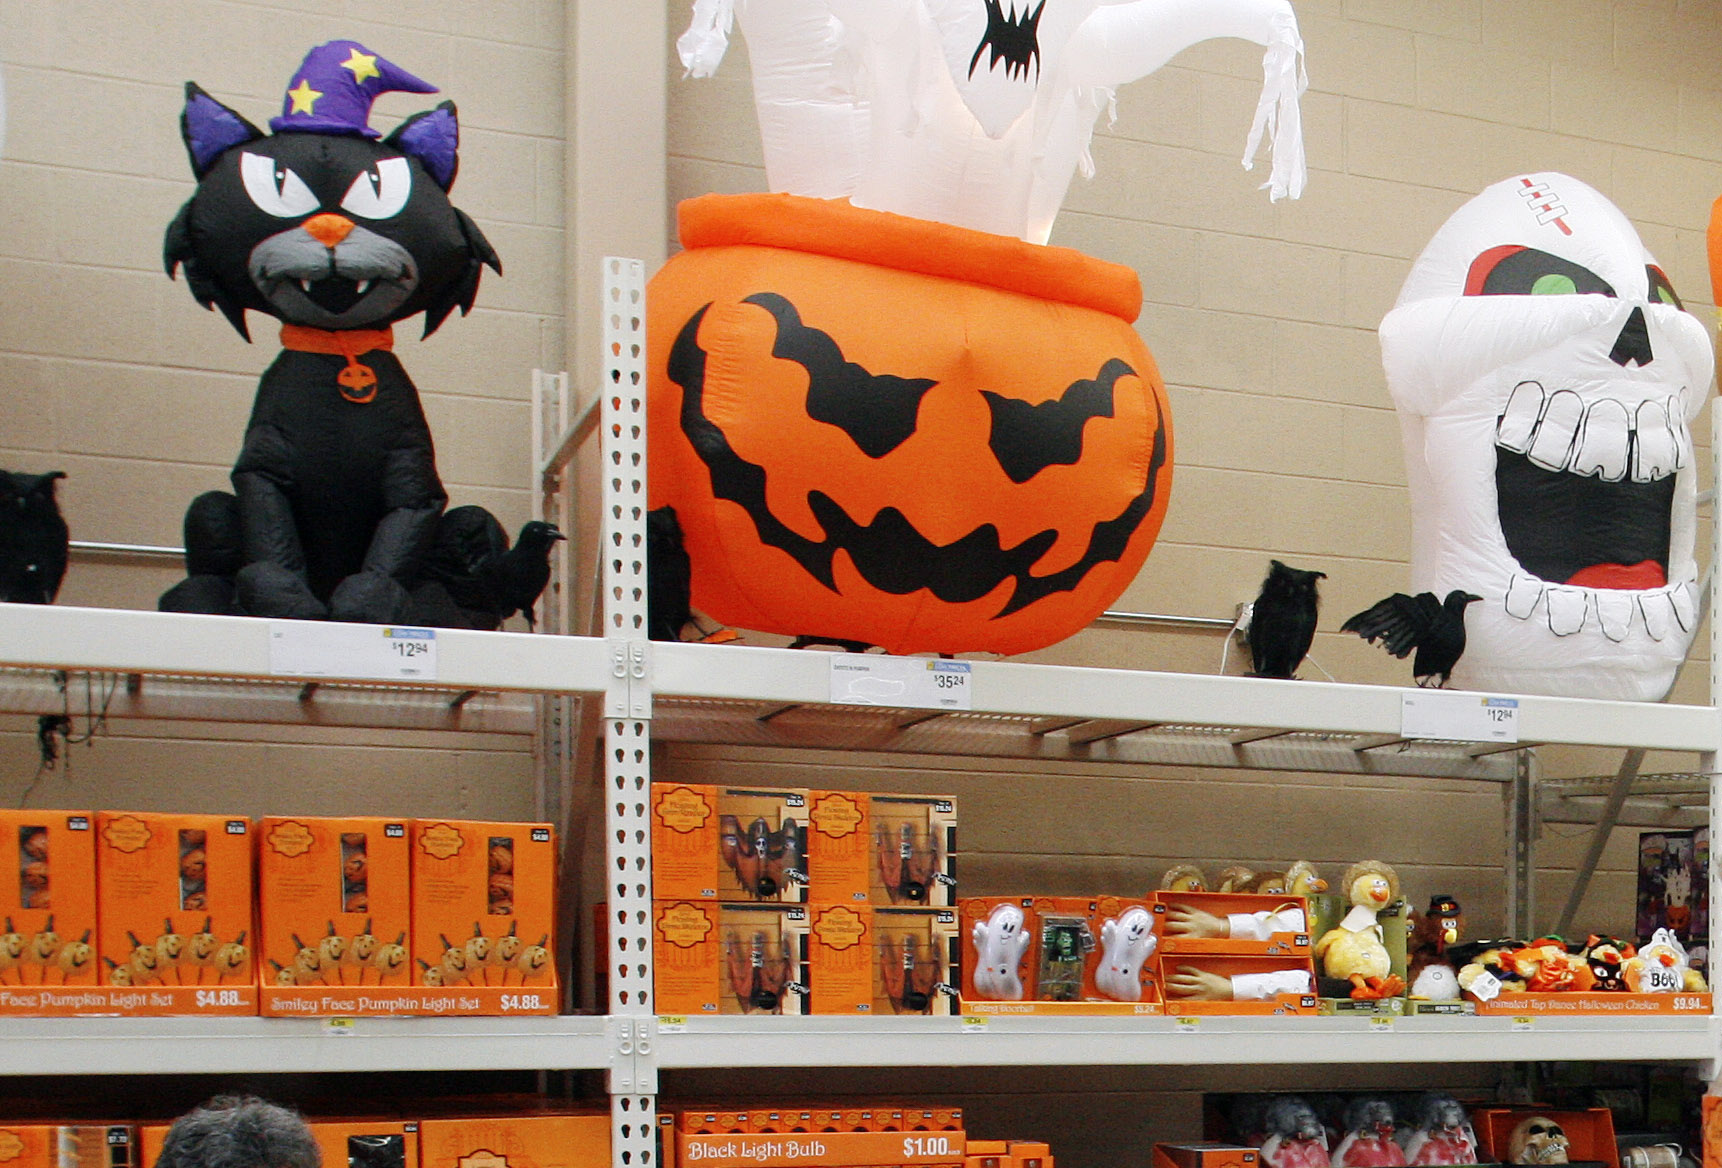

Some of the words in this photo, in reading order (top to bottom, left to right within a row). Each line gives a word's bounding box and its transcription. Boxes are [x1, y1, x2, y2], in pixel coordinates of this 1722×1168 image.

[40, 992, 106, 1009] Pumpkin
[109, 991, 146, 1008] Light
[150, 992, 173, 1006] Set
[195, 990, 239, 1008] $4.88
[271, 997, 318, 1013] Smiley
[322, 997, 355, 1011] Face
[358, 998, 418, 1013] Pumpkin
[422, 997, 456, 1012] Light
[459, 997, 480, 1010] Set
[500, 995, 540, 1011] $4.88
[1673, 997, 1700, 1010] $9.94
[688, 1141, 737, 1160] Black
[741, 1141, 782, 1161] Light
[785, 1141, 826, 1158] Bulb
[903, 1137, 948, 1157] $1.00
